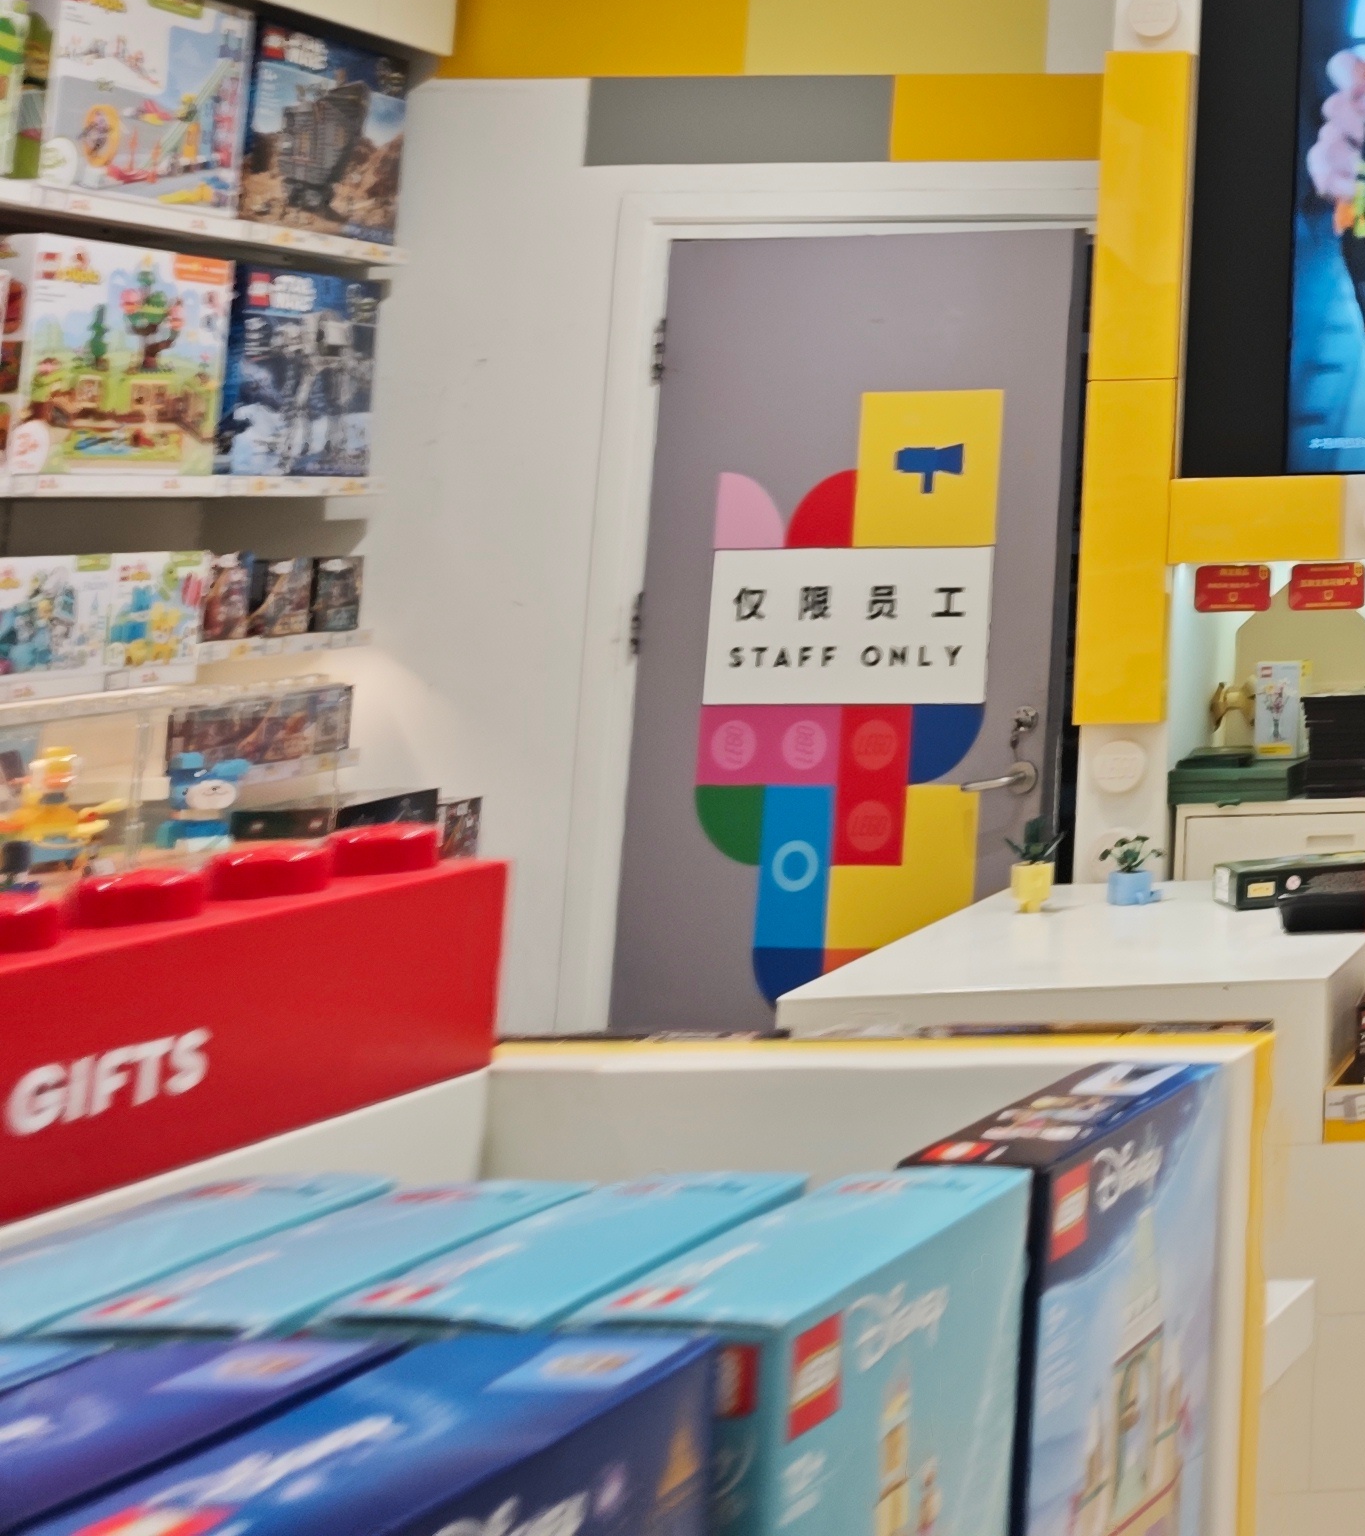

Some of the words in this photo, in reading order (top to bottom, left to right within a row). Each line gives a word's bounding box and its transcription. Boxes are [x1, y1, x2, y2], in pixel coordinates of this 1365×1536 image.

[732, 584, 967, 622] 仅限员工
[728, 646, 837, 668] STAFF
[860, 645, 962, 668] ONLY
[4, 1027, 212, 1136] GIFTS
